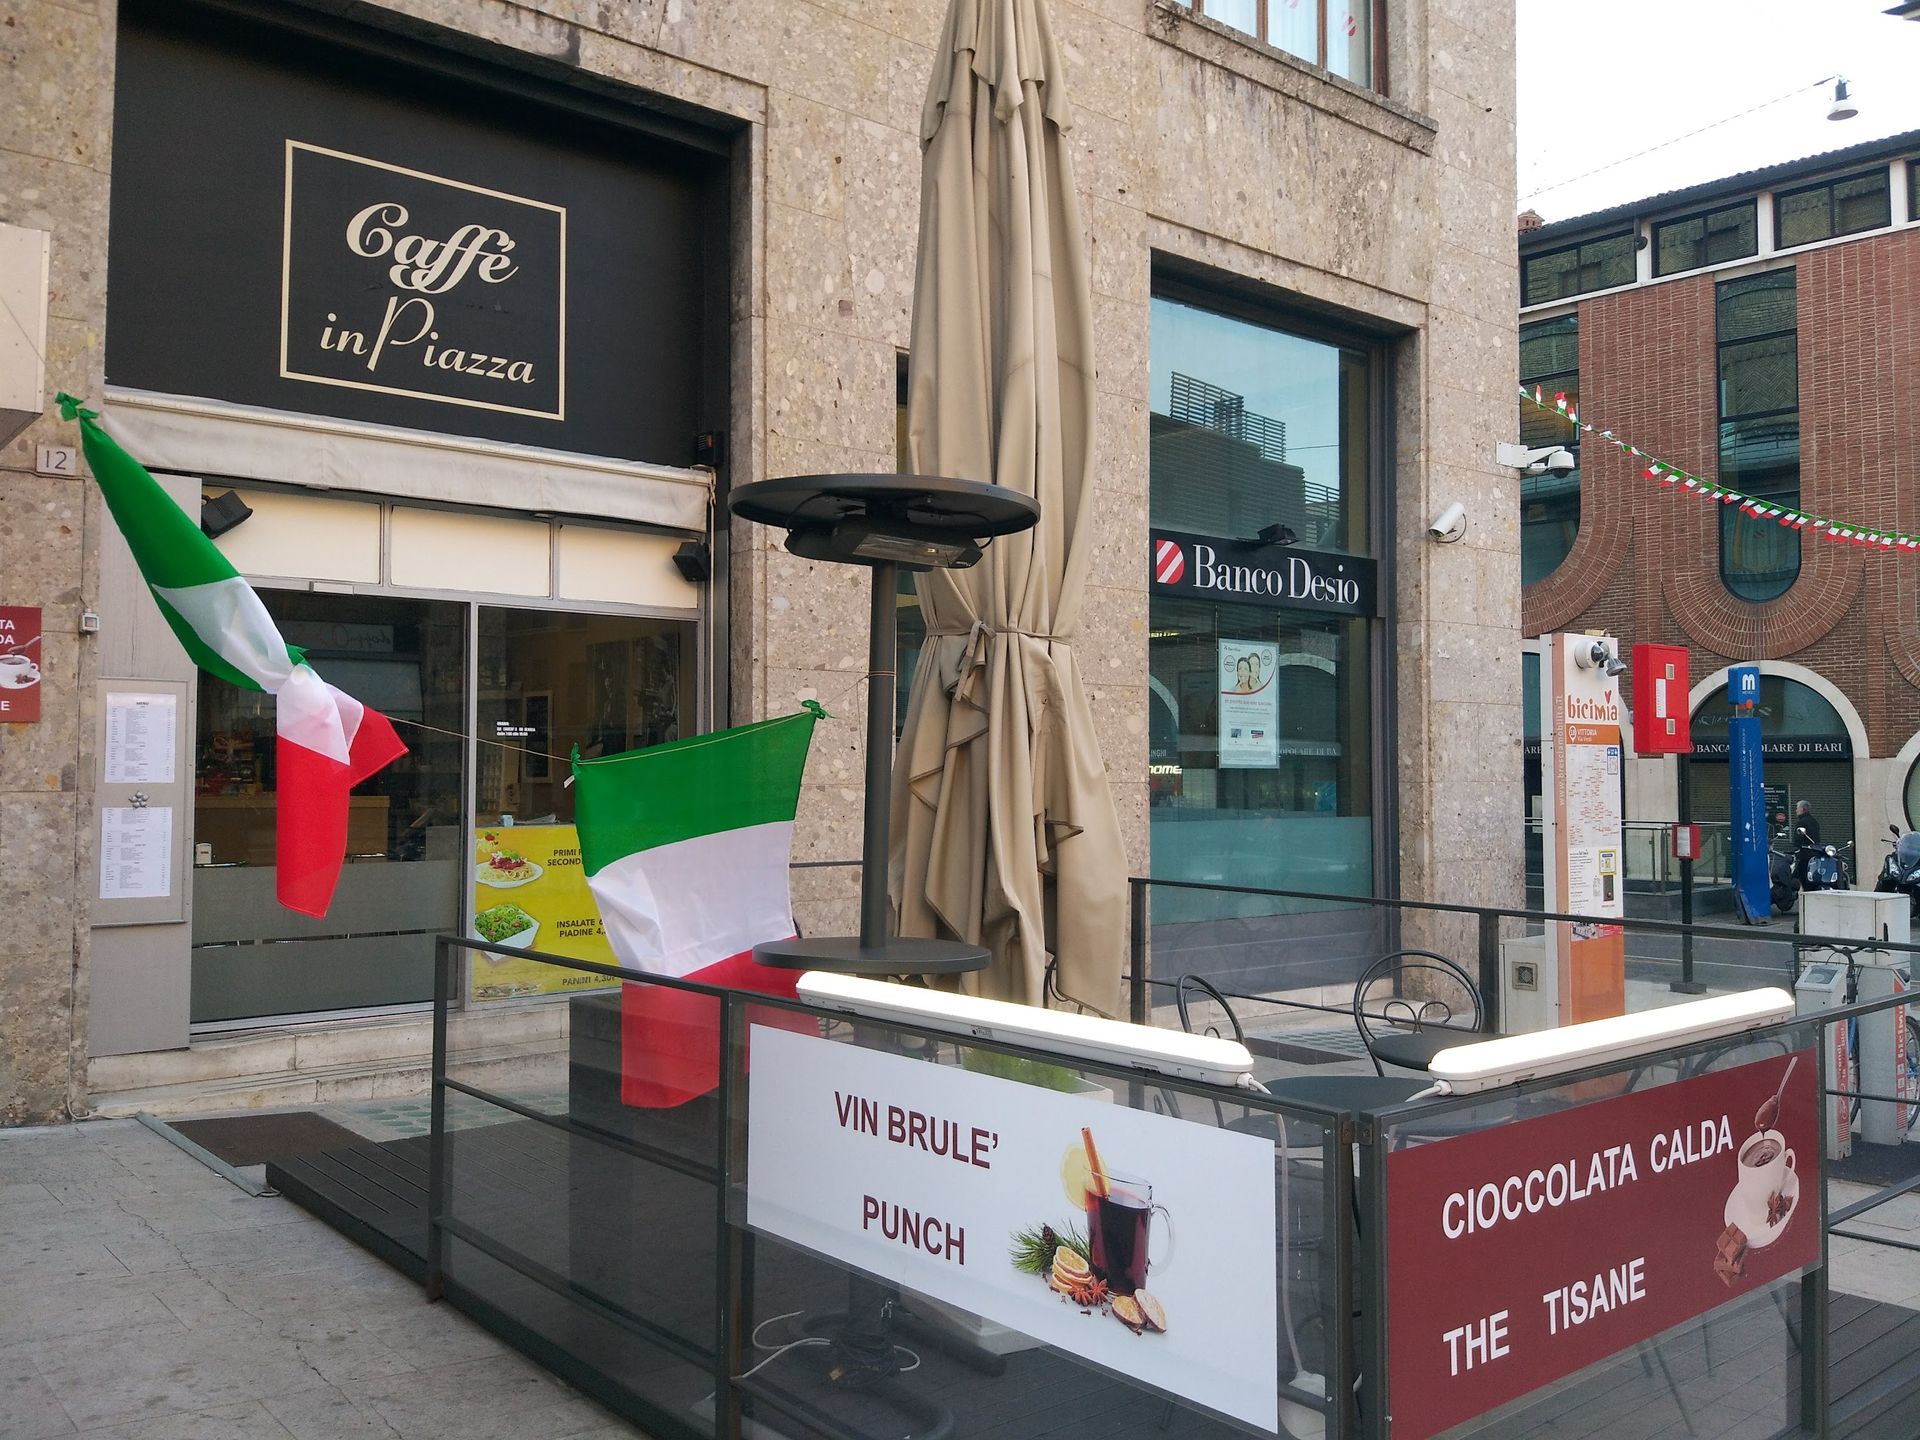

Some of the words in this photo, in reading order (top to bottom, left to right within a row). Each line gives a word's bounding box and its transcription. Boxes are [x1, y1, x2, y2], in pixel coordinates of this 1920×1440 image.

[319, 312, 367, 355] in
[366, 296, 536, 384] Piazza
[46, 450, 67, 470] 12
[1192, 544, 1283, 597] Banco
[1287, 557, 1360, 605] Desio
[1567, 690, 1618, 721] bicimia
[1799, 743, 1810, 752] DI
[1815, 742, 1842, 752] BARI
[556, 918, 595, 928] INSALATE
[559, 928, 594, 937] PIADINE
[562, 976, 591, 985] PANINI
[834, 1091, 878, 1137] VIN
[1442, 1143, 1638, 1240] CIOCCOLATA
[1650, 1115, 1733, 1173] CALDA
[863, 1194, 965, 1266] PUNCH
[1443, 1309, 1510, 1377] THE
[1543, 1257, 1646, 1336] TISANE
